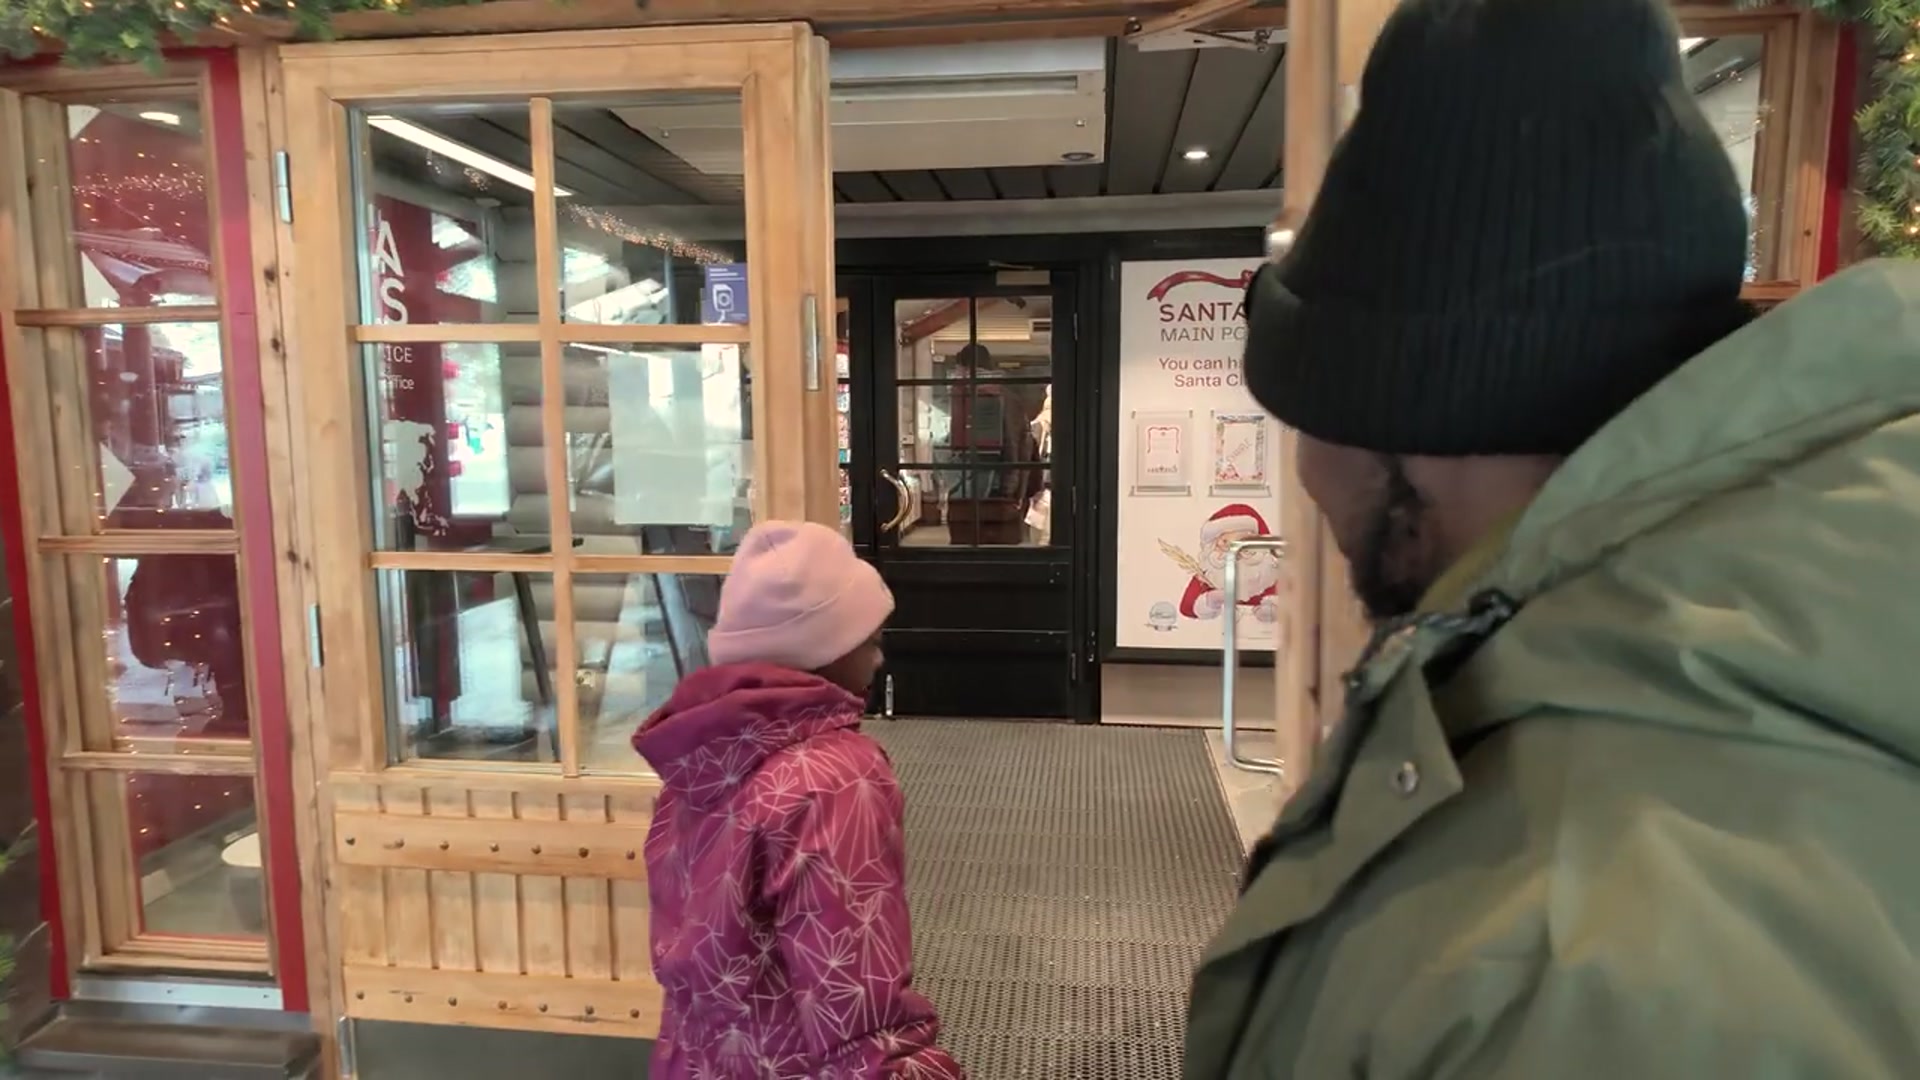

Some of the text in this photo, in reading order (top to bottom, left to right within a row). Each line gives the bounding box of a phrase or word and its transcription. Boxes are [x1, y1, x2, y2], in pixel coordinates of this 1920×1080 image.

[1159, 302, 1248, 322] SANTA
[1160, 327, 1214, 342] MAIN
[1159, 357, 1188, 371] You
[1193, 359, 1223, 370] can
[1174, 374, 1222, 388] Santa
